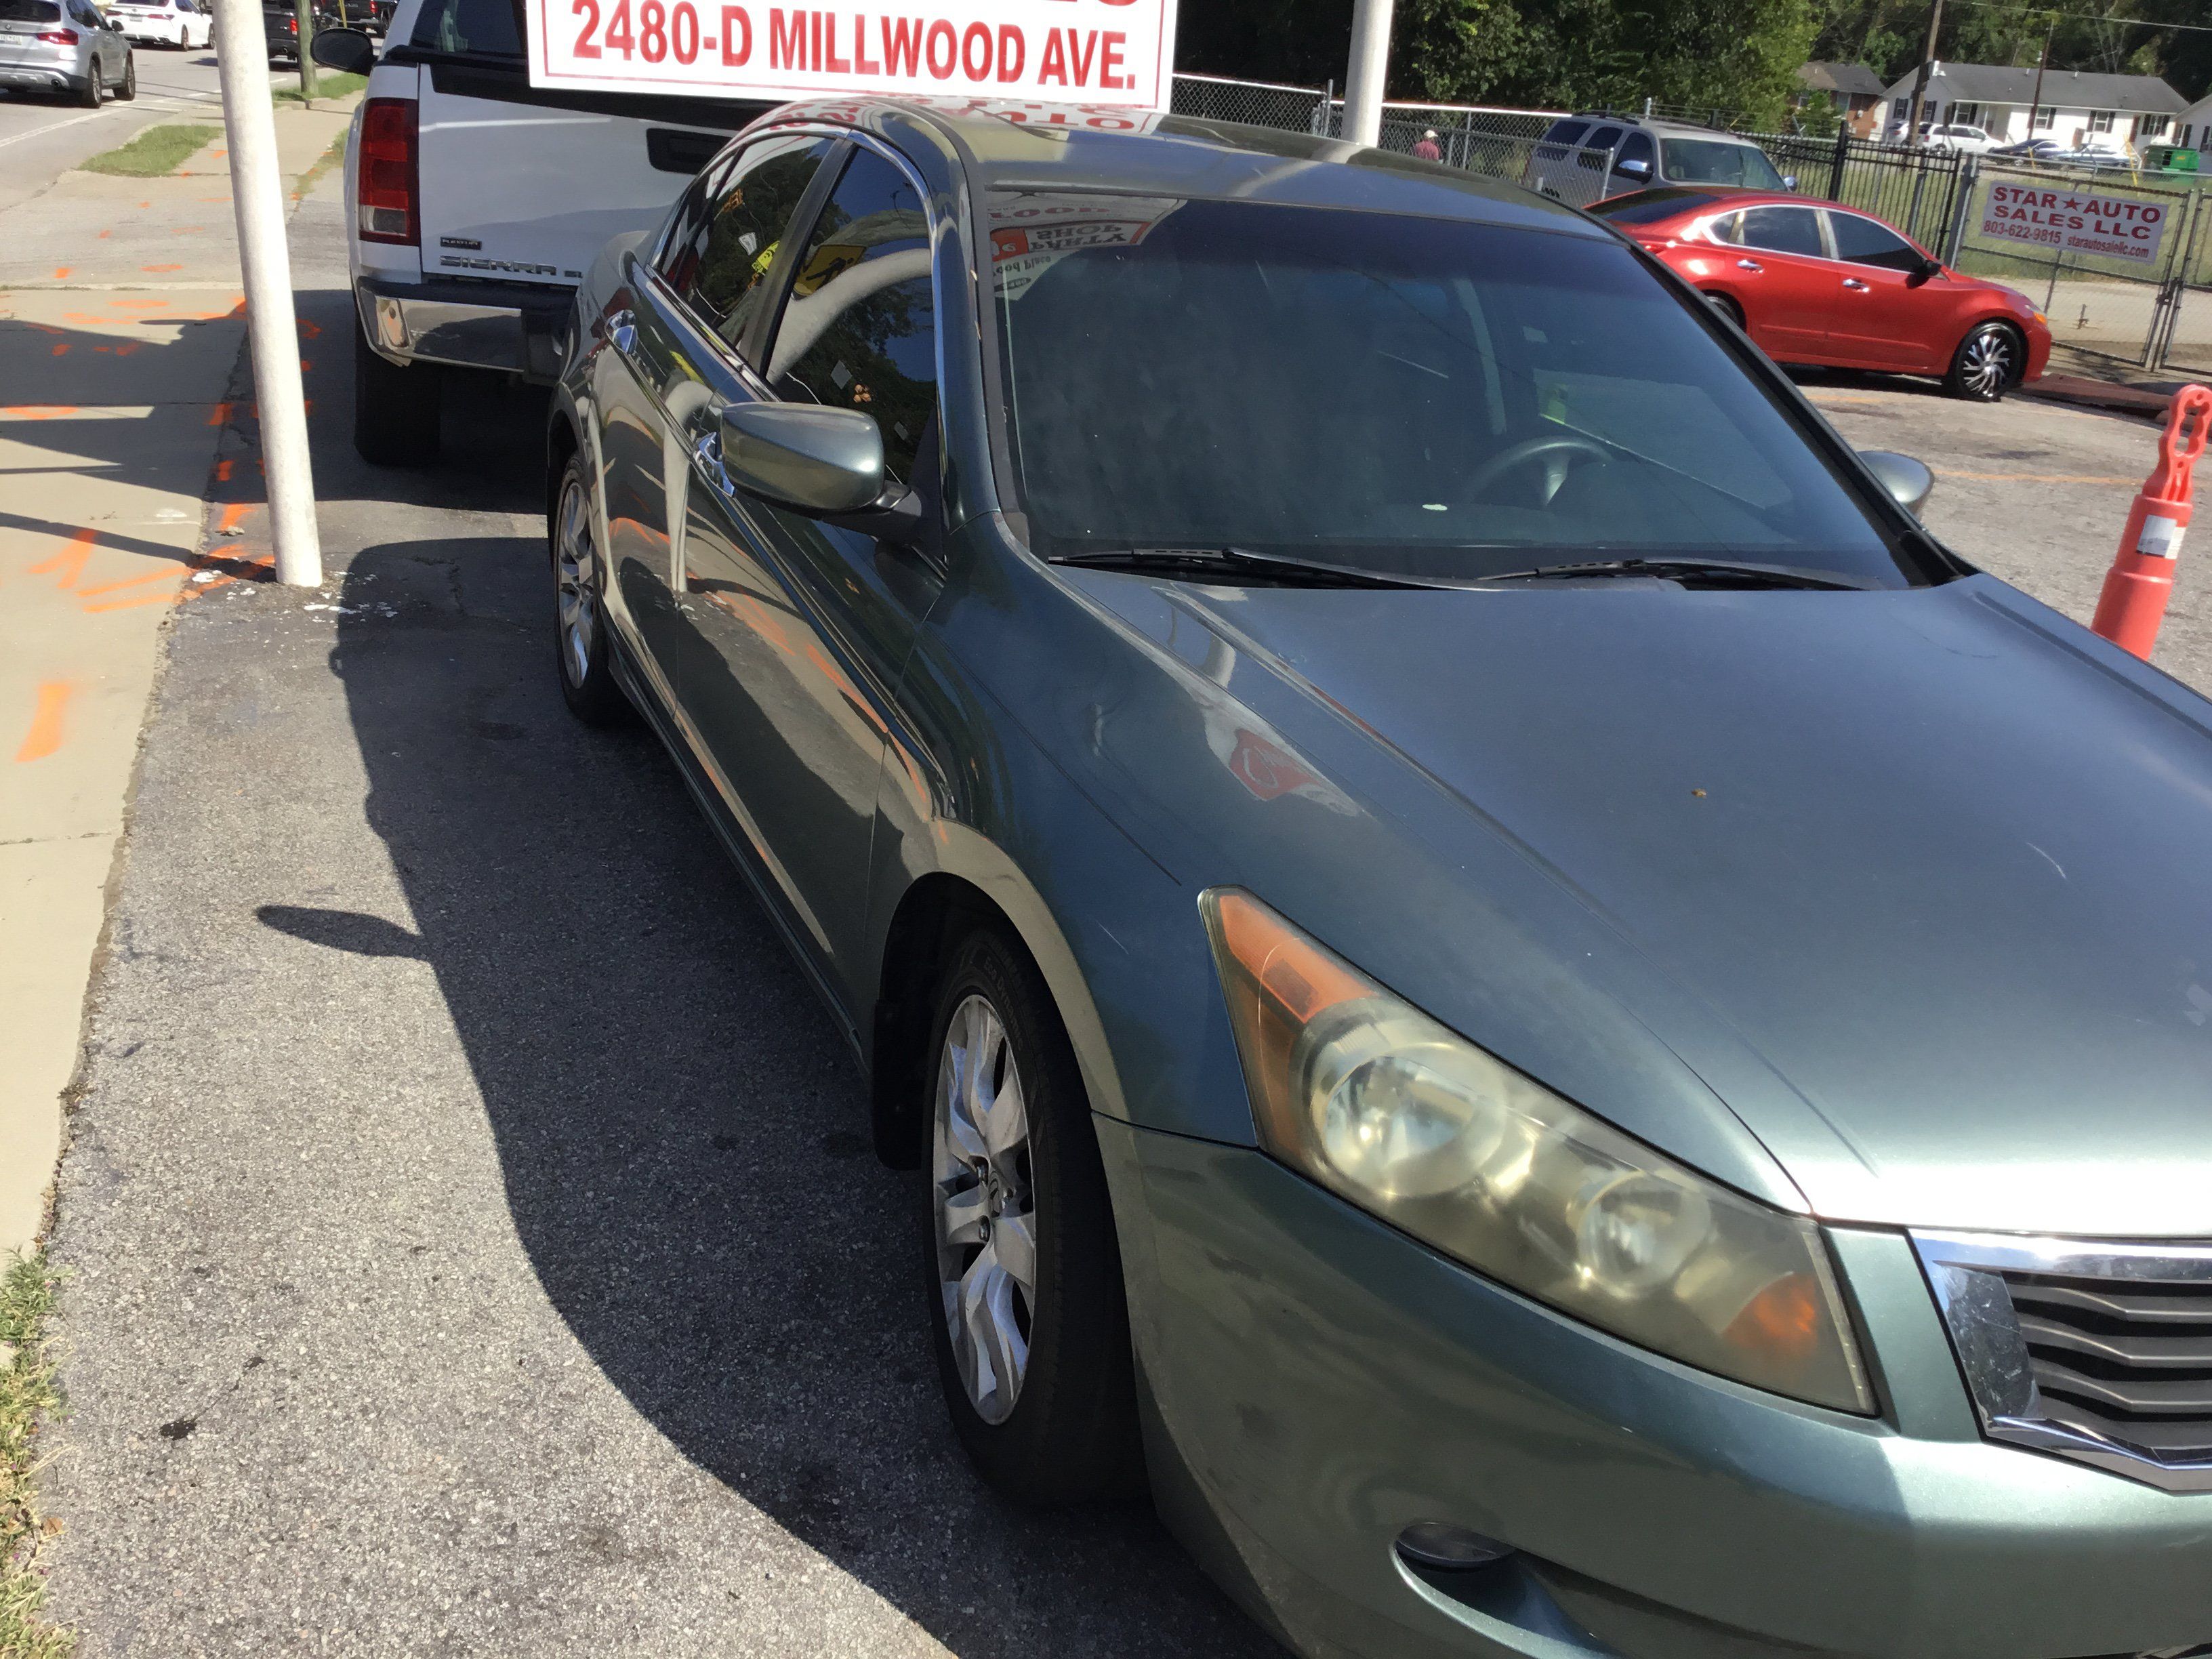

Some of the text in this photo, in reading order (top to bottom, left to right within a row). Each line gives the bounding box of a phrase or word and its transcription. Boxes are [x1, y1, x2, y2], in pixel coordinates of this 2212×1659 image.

[572, 0, 1136, 89] 2480-D MILLWOOD AVE.
[1993, 186, 2160, 224] STAR AUTO
[1994, 205, 2151, 240] SALES LLC
[1984, 220, 2062, 243] 803-622-9815
